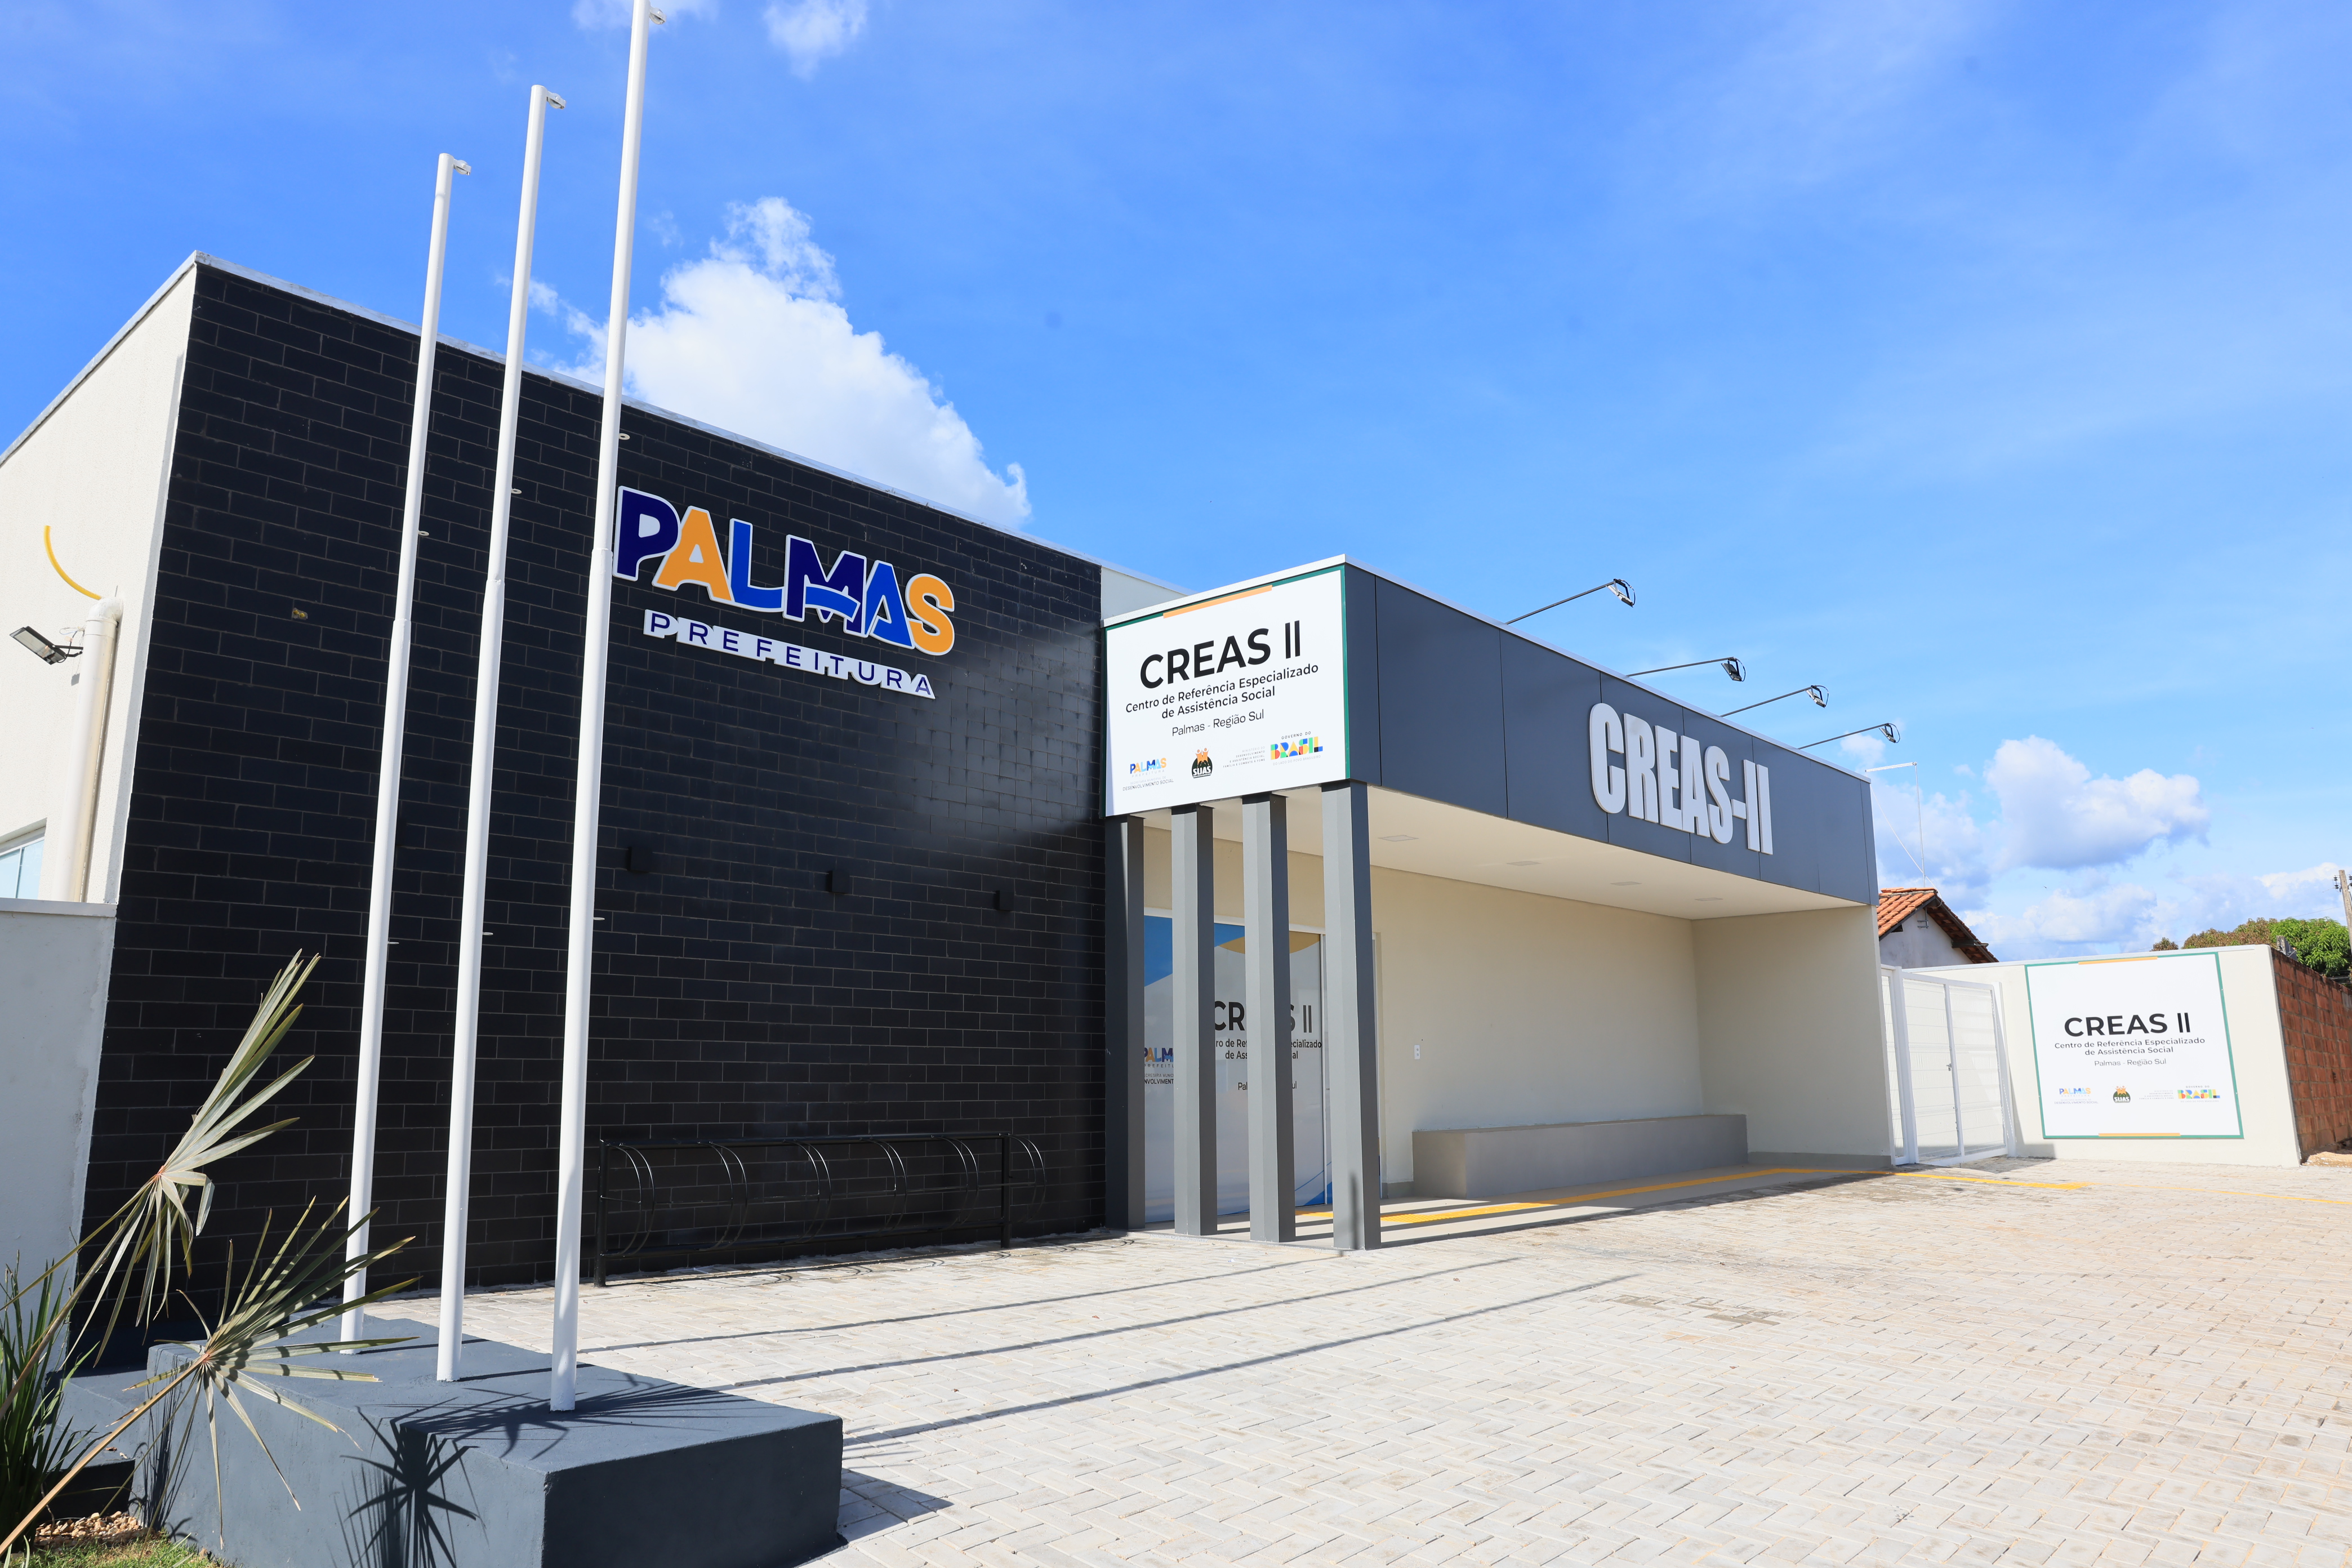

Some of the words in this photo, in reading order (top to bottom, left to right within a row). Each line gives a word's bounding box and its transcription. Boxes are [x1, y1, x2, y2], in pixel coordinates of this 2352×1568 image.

[613, 485, 955, 656] PALMAS
[648, 613, 933, 697] PREFEITURA
[1140, 628, 1271, 689] CREAS
[1285, 620, 1300, 659] II
[1126, 700, 1159, 713] Centro
[1162, 694, 1174, 705] de
[1178, 680, 1235, 701] Referência
[1240, 663, 1318, 688] Especializado
[1162, 708, 1174, 719] de
[1178, 696, 1238, 716] Assistência
[1241, 685, 1275, 702] Social
[1172, 723, 1205, 736] Palmas
[1213, 714, 1246, 728] Região
[1249, 709, 1264, 721] Sul
[1270, 736, 1323, 760] BRASIL
[1130, 758, 1166, 774] PALMAS
[1132, 769, 1165, 778] PREFEITURA
[1193, 765, 1211, 776] SUAS
[1122, 781, 1159, 791] DESENVOLVIMENTO
[1589, 703, 1773, 855] CREAS-II
[1303, 1005, 1312, 1033] II
[2064, 1013, 2168, 1037] CREAS
[2177, 1012, 2191, 1033] II
[1226, 1039, 1235, 1048] de
[2145, 1037, 2205, 1046] Especializado
[1226, 1050, 1235, 1059] de
[2177, 1089, 2220, 1099] BRASIL
